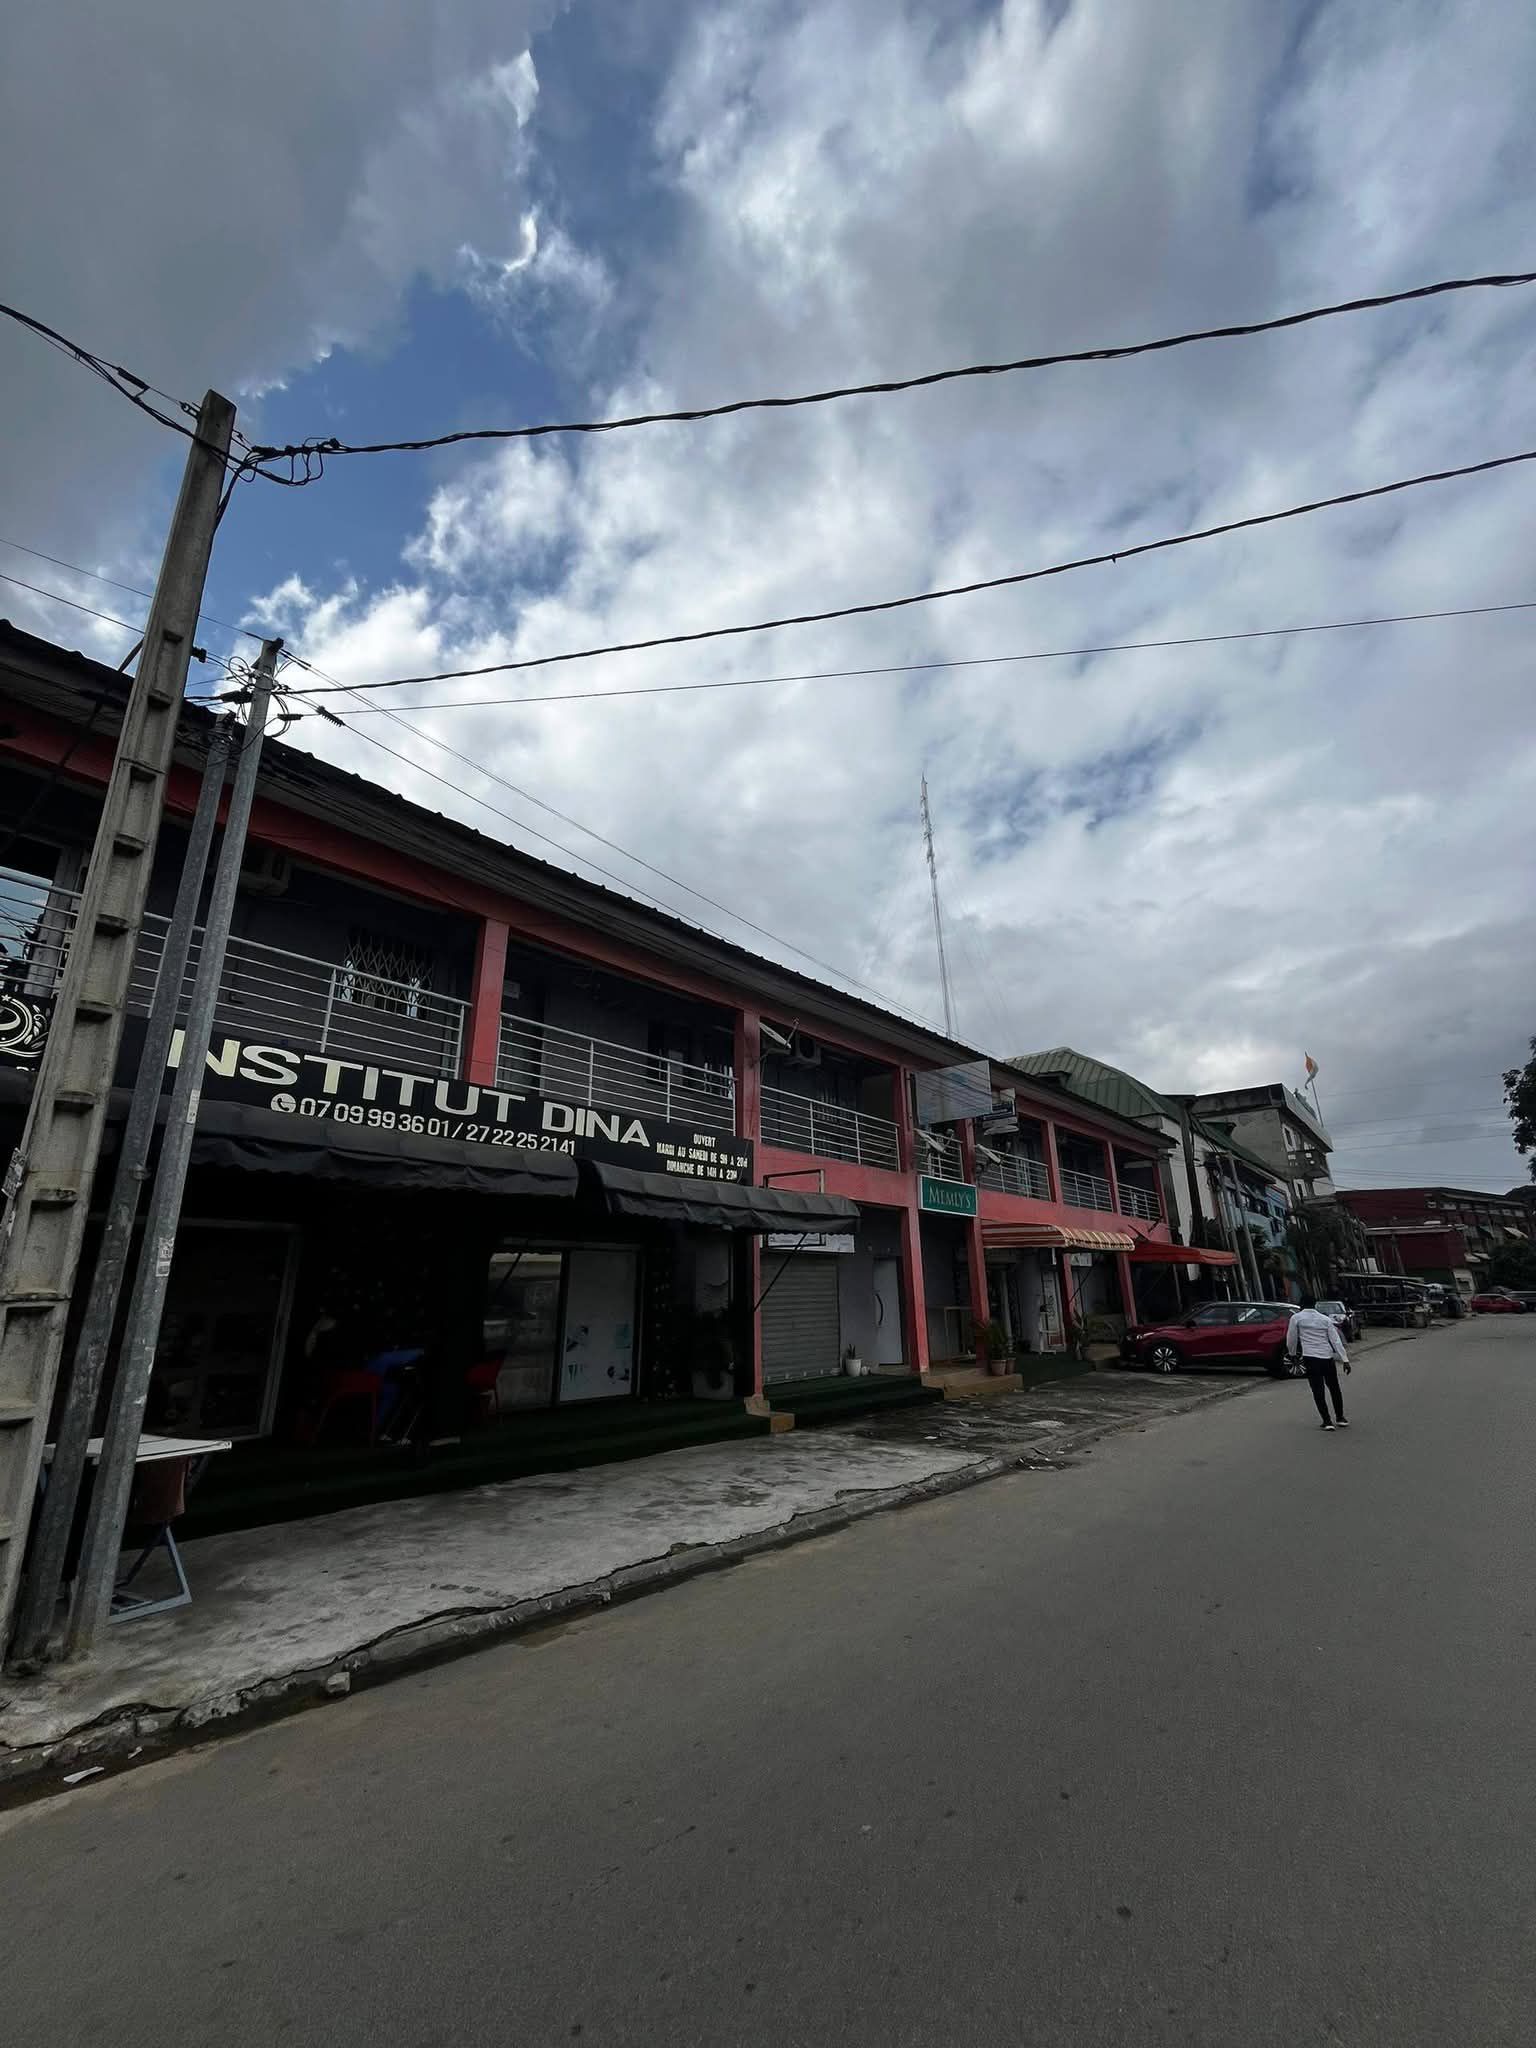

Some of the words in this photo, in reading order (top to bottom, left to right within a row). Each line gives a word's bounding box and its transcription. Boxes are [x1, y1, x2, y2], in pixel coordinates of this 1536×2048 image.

[167, 1029, 526, 1123] INSTITUT
[541, 1101, 650, 1147] DINA
[299, 1097, 332, 1118] 07
[333, 1103, 364, 1124] 09
[367, 1108, 396, 1129] 99
[398, 1113, 425, 1133] 36
[427, 1118, 449, 1137] 01
[465, 1123, 490, 1142] 27
[491, 1128, 515, 1146] 22
[516, 1131, 538, 1150] 25
[693, 1133, 716, 1148] OUVERT
[677, 1146, 686, 1158] AU
[688, 1148, 708, 1162] SAMEDI
[710, 1152, 718, 1163] DE
[666, 1160, 695, 1175] DIMANCHE
[697, 1164, 704, 1176] DE
